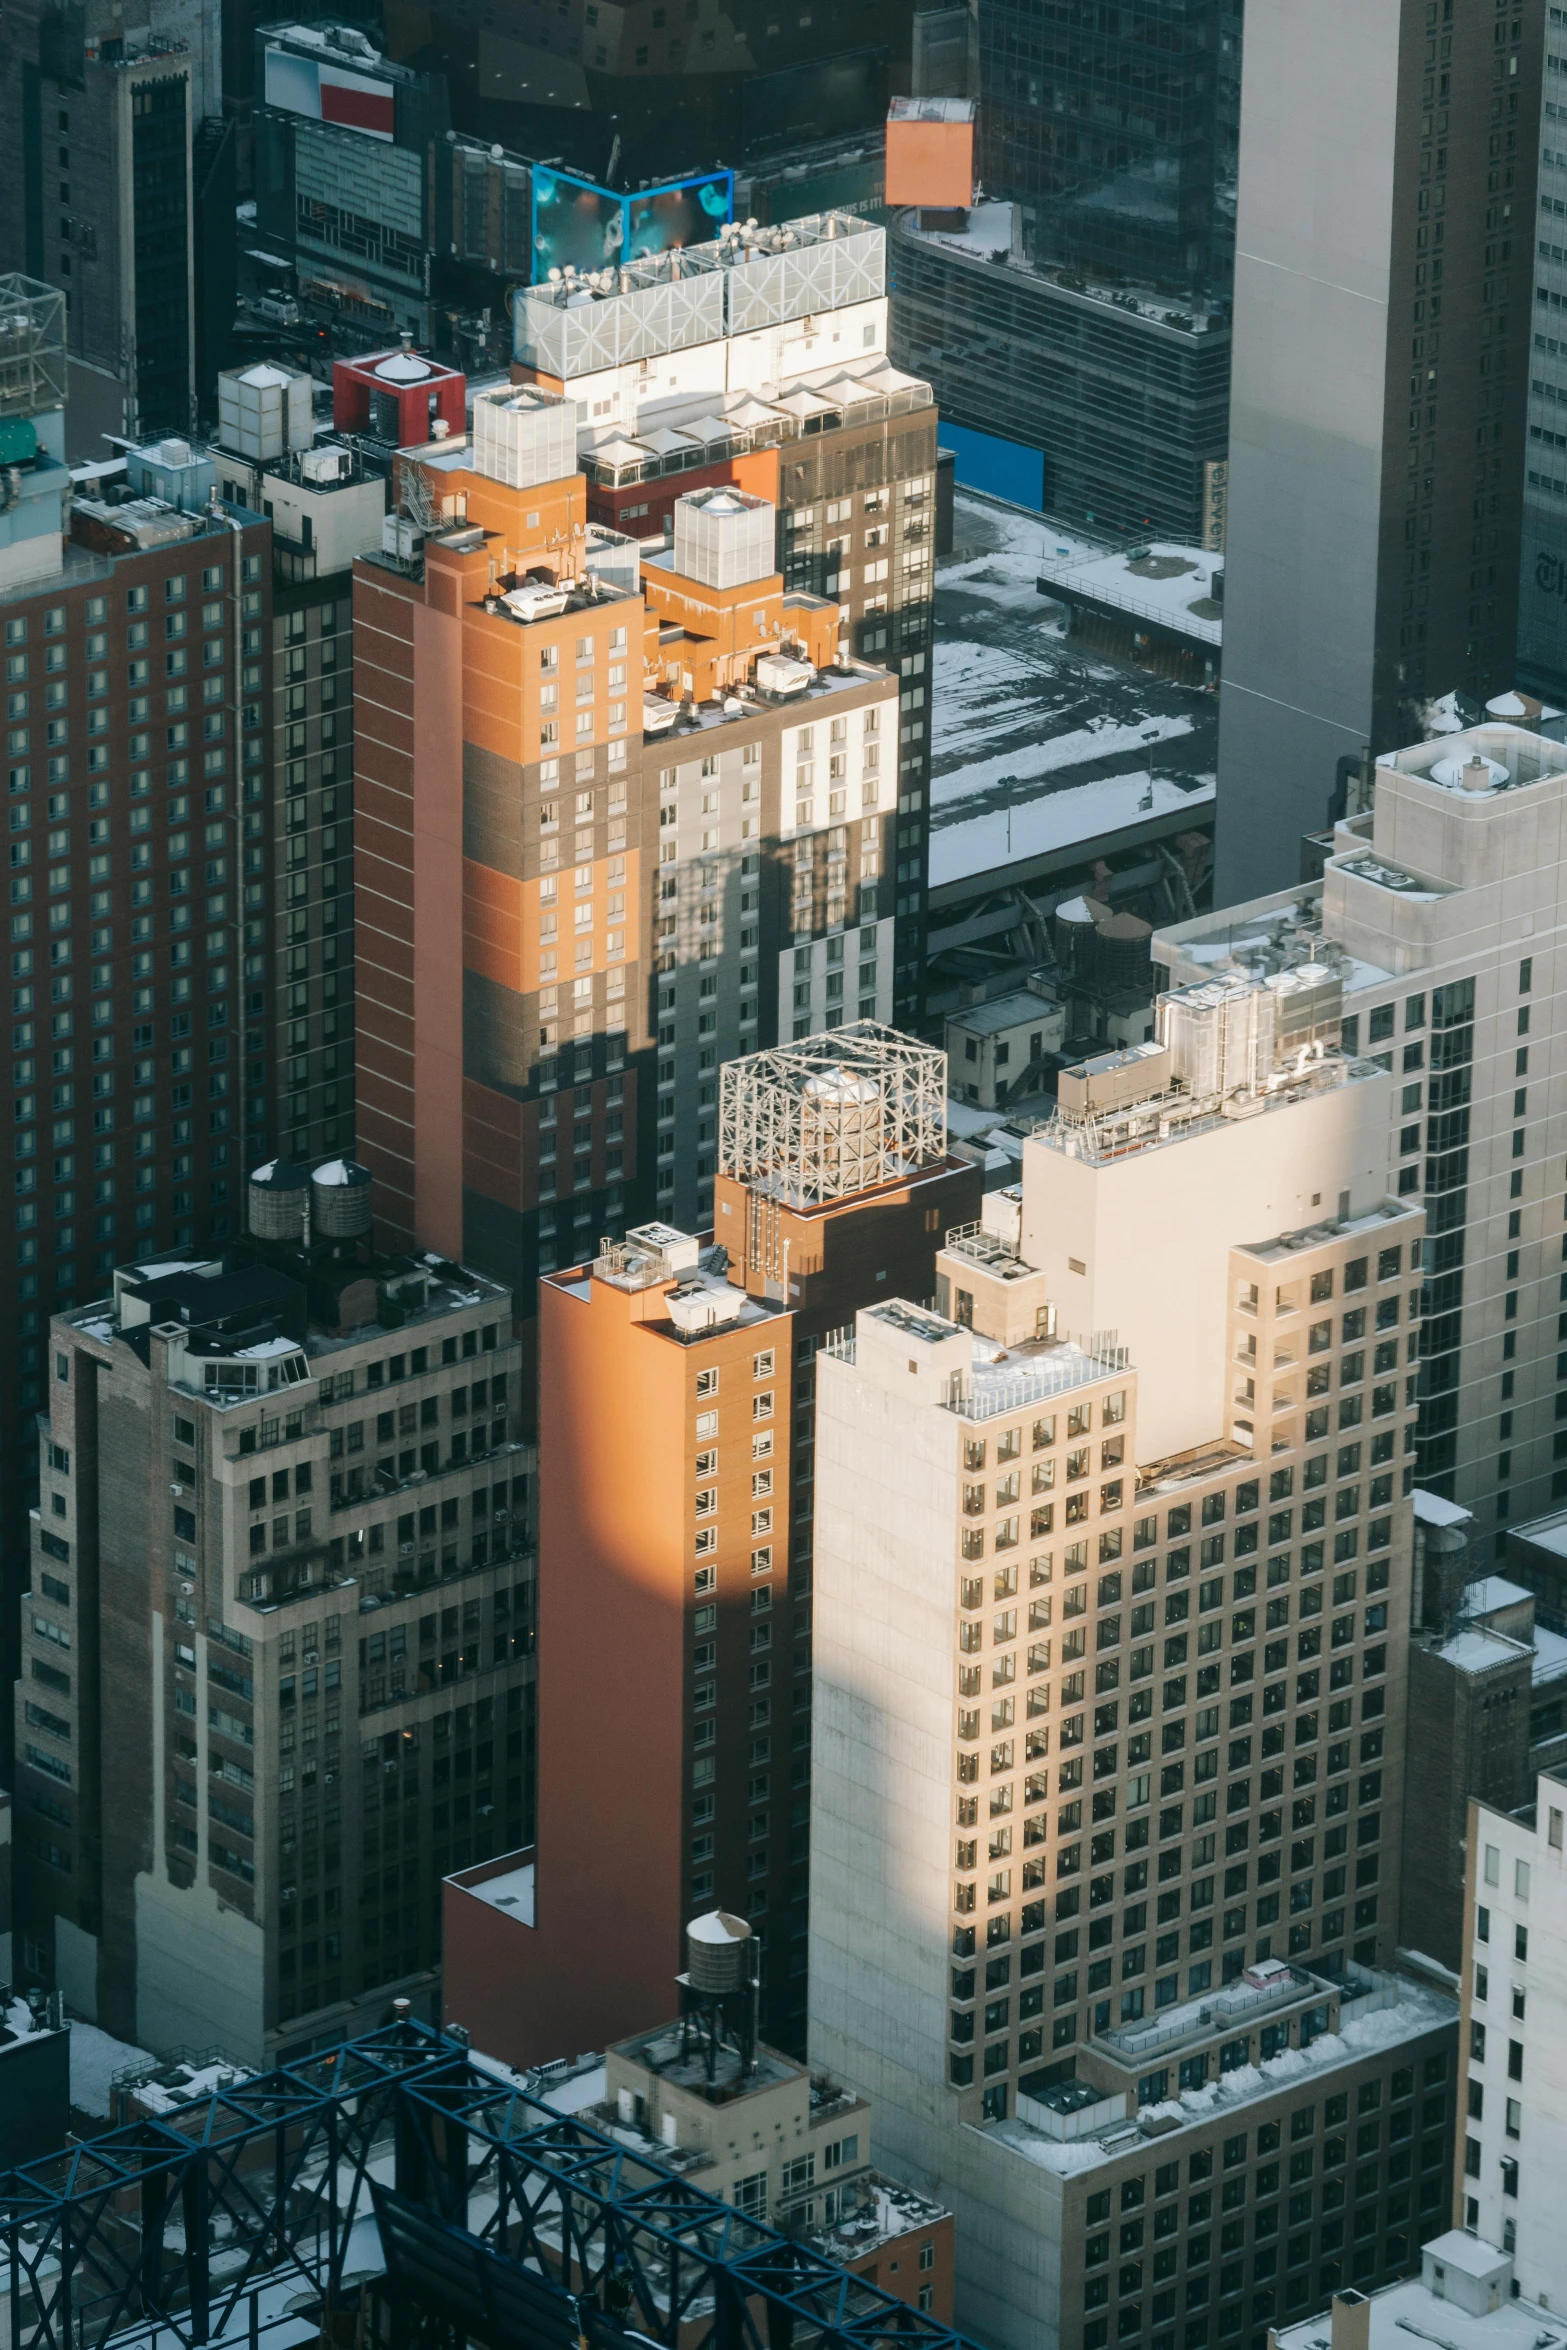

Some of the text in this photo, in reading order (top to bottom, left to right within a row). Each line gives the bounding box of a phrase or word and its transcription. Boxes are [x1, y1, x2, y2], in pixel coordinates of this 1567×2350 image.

[859, 199, 869, 213] IS
[869, 196, 882, 211] IT!
[1211, 466, 1227, 553] eleven
